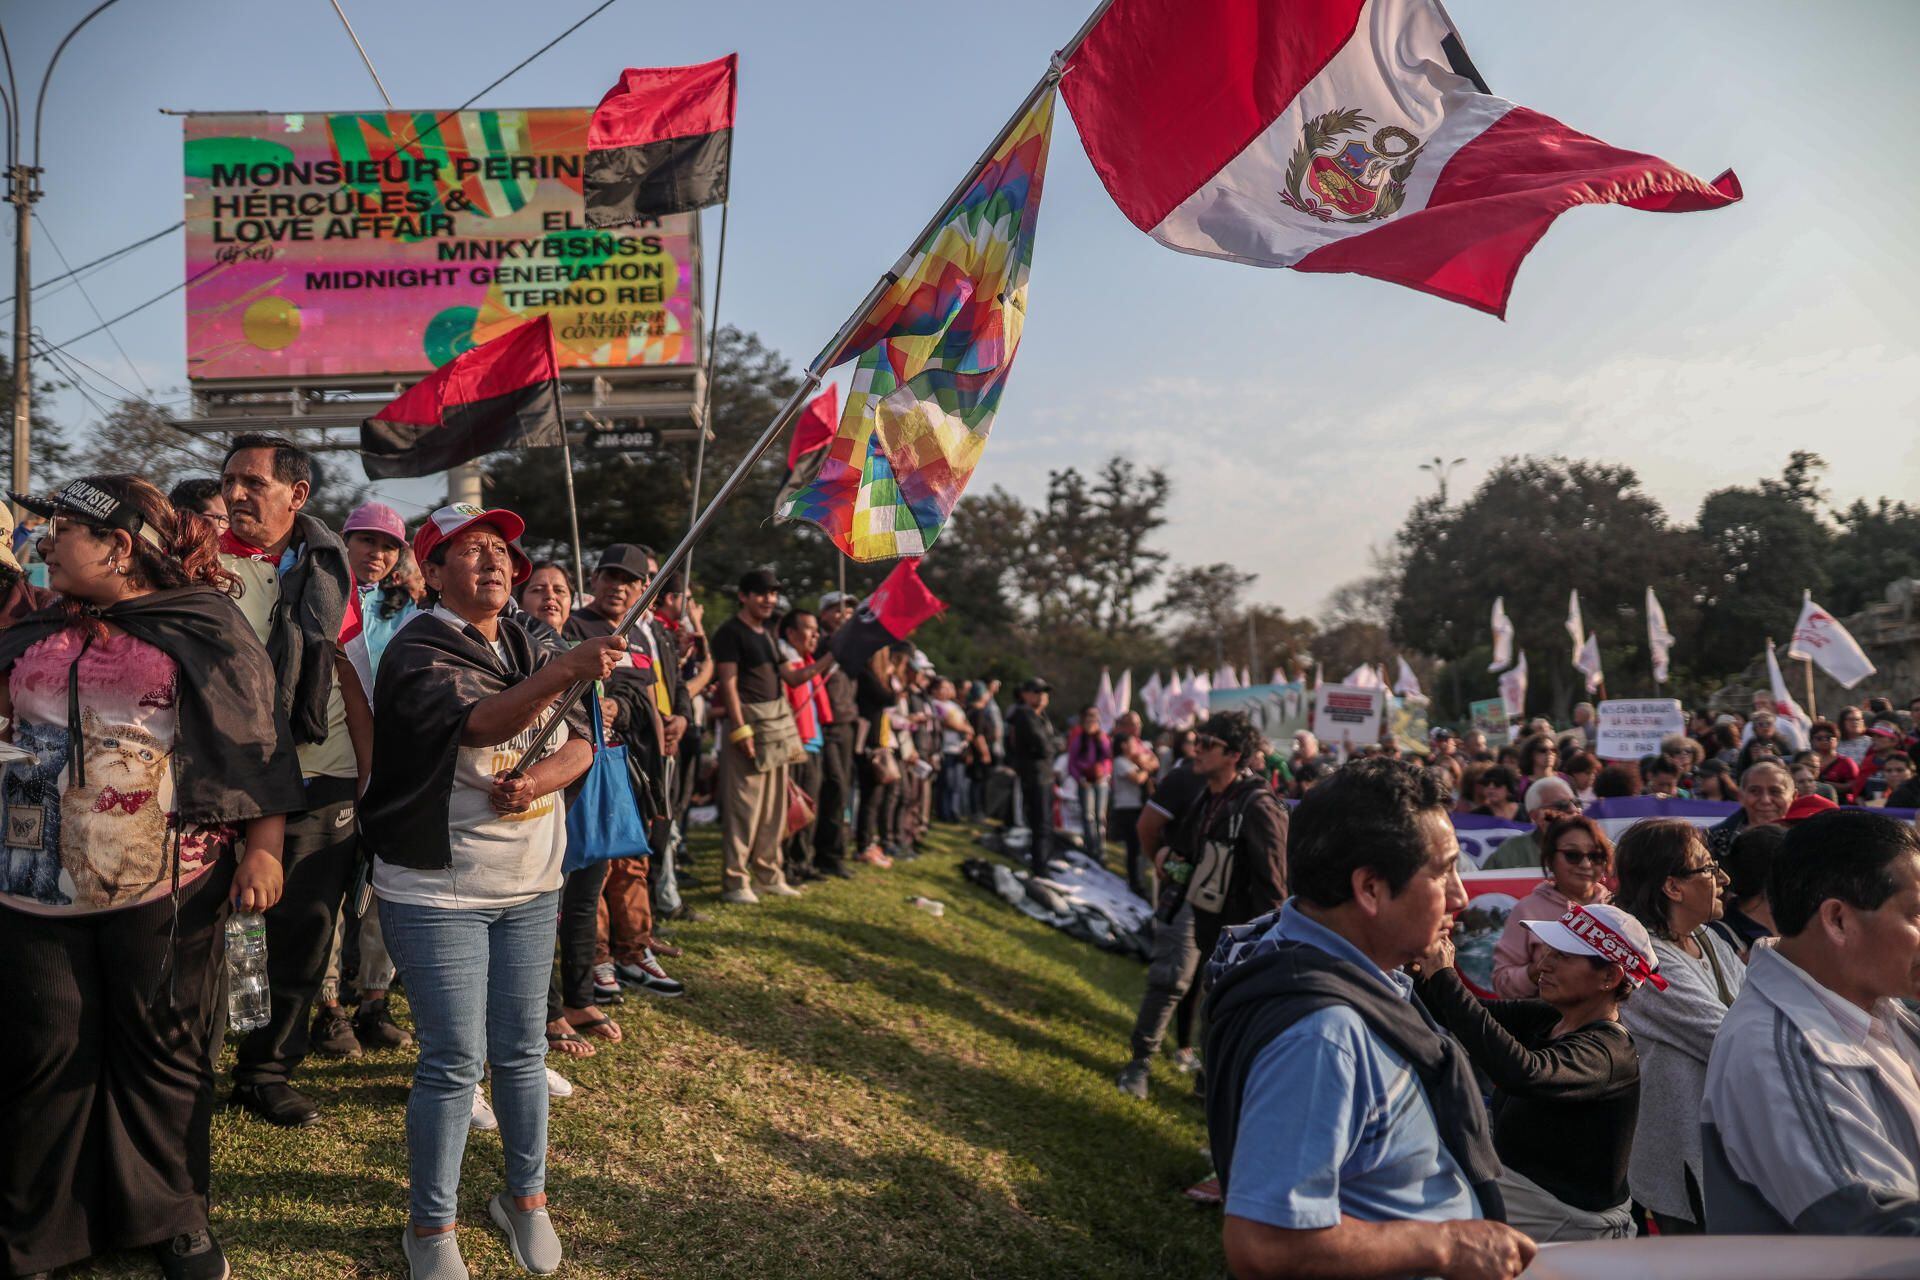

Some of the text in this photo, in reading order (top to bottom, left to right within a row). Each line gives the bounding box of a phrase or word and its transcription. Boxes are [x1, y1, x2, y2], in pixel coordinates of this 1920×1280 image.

[212, 155, 581, 187] MONSIEUR PERIN
[213, 189, 472, 218] HÉRCULES &
[213, 213, 456, 243] LOVE AFFAIR
[542, 211, 582, 230] EL
[438, 236, 664, 260] MNKYBSNSS
[305, 262, 664, 290] MIDNIGHT GENERATION
[504, 287, 607, 307] TERNO
[577, 308, 666, 325] Y MÁS POR
[561, 325, 666, 339] CONFIRMAR
